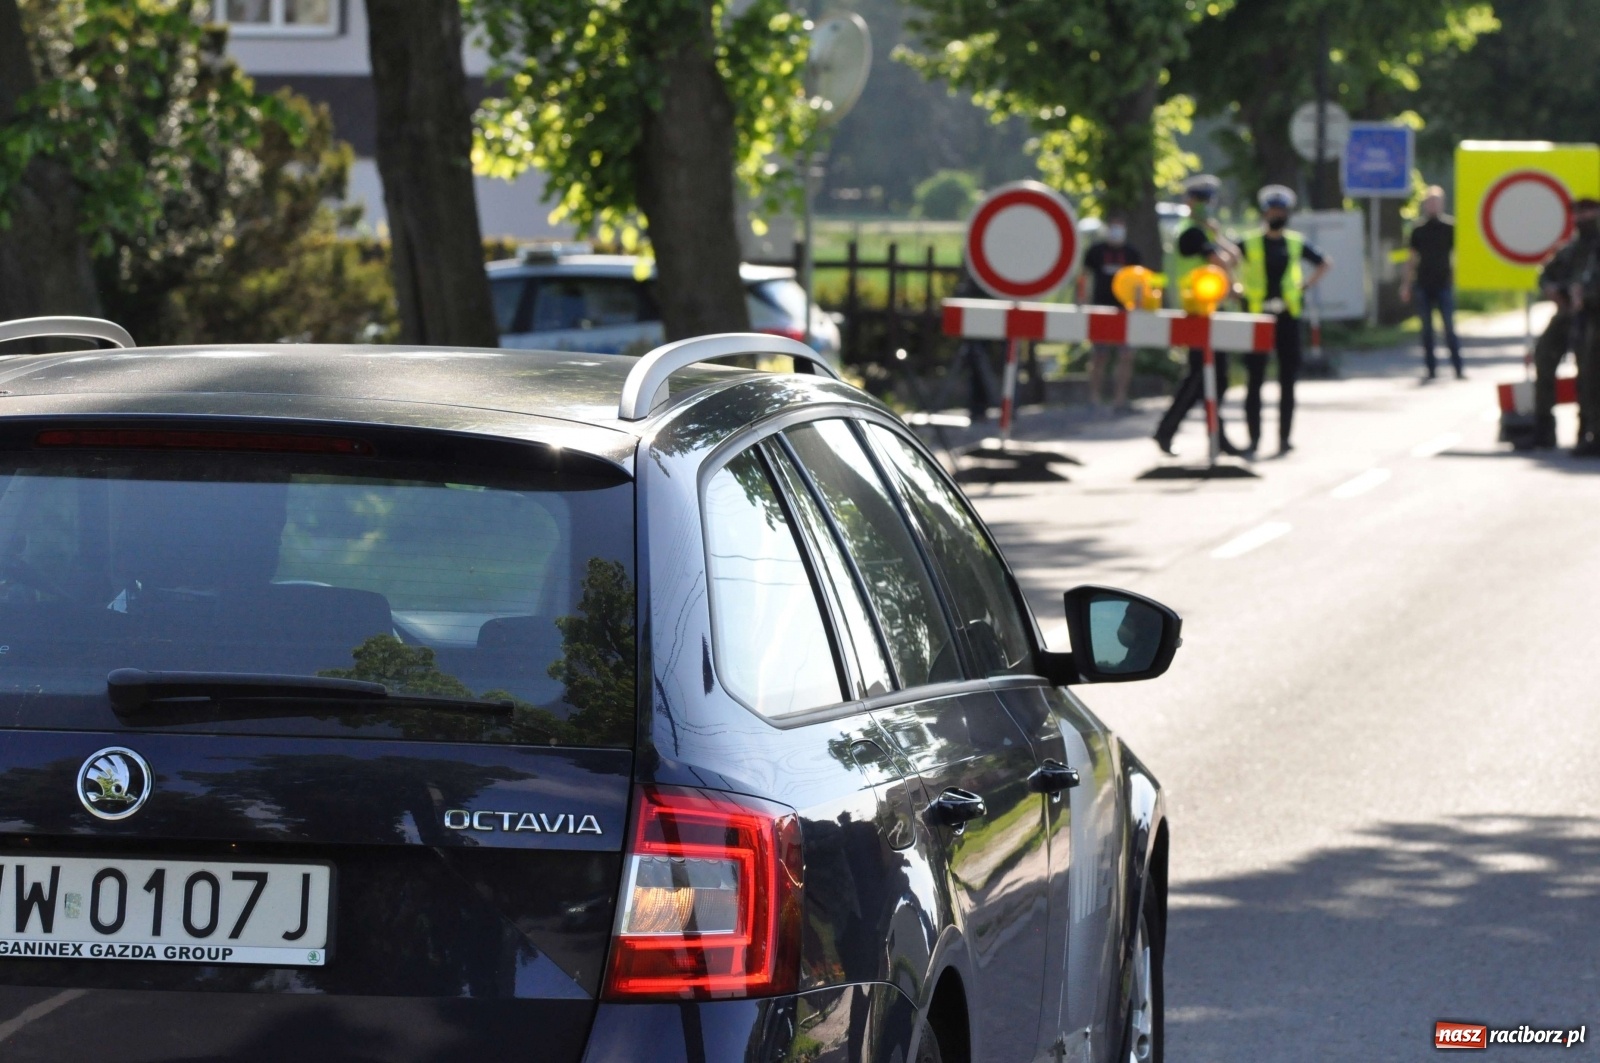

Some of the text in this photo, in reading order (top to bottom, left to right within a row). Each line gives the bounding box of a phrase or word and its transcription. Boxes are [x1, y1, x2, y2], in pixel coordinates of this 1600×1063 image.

[444, 809, 603, 834] OCTAVIA
[0, 864, 311, 941] W 0107J
[89, 943, 157, 959] GAZDA
[163, 946, 234, 961] GROUP
